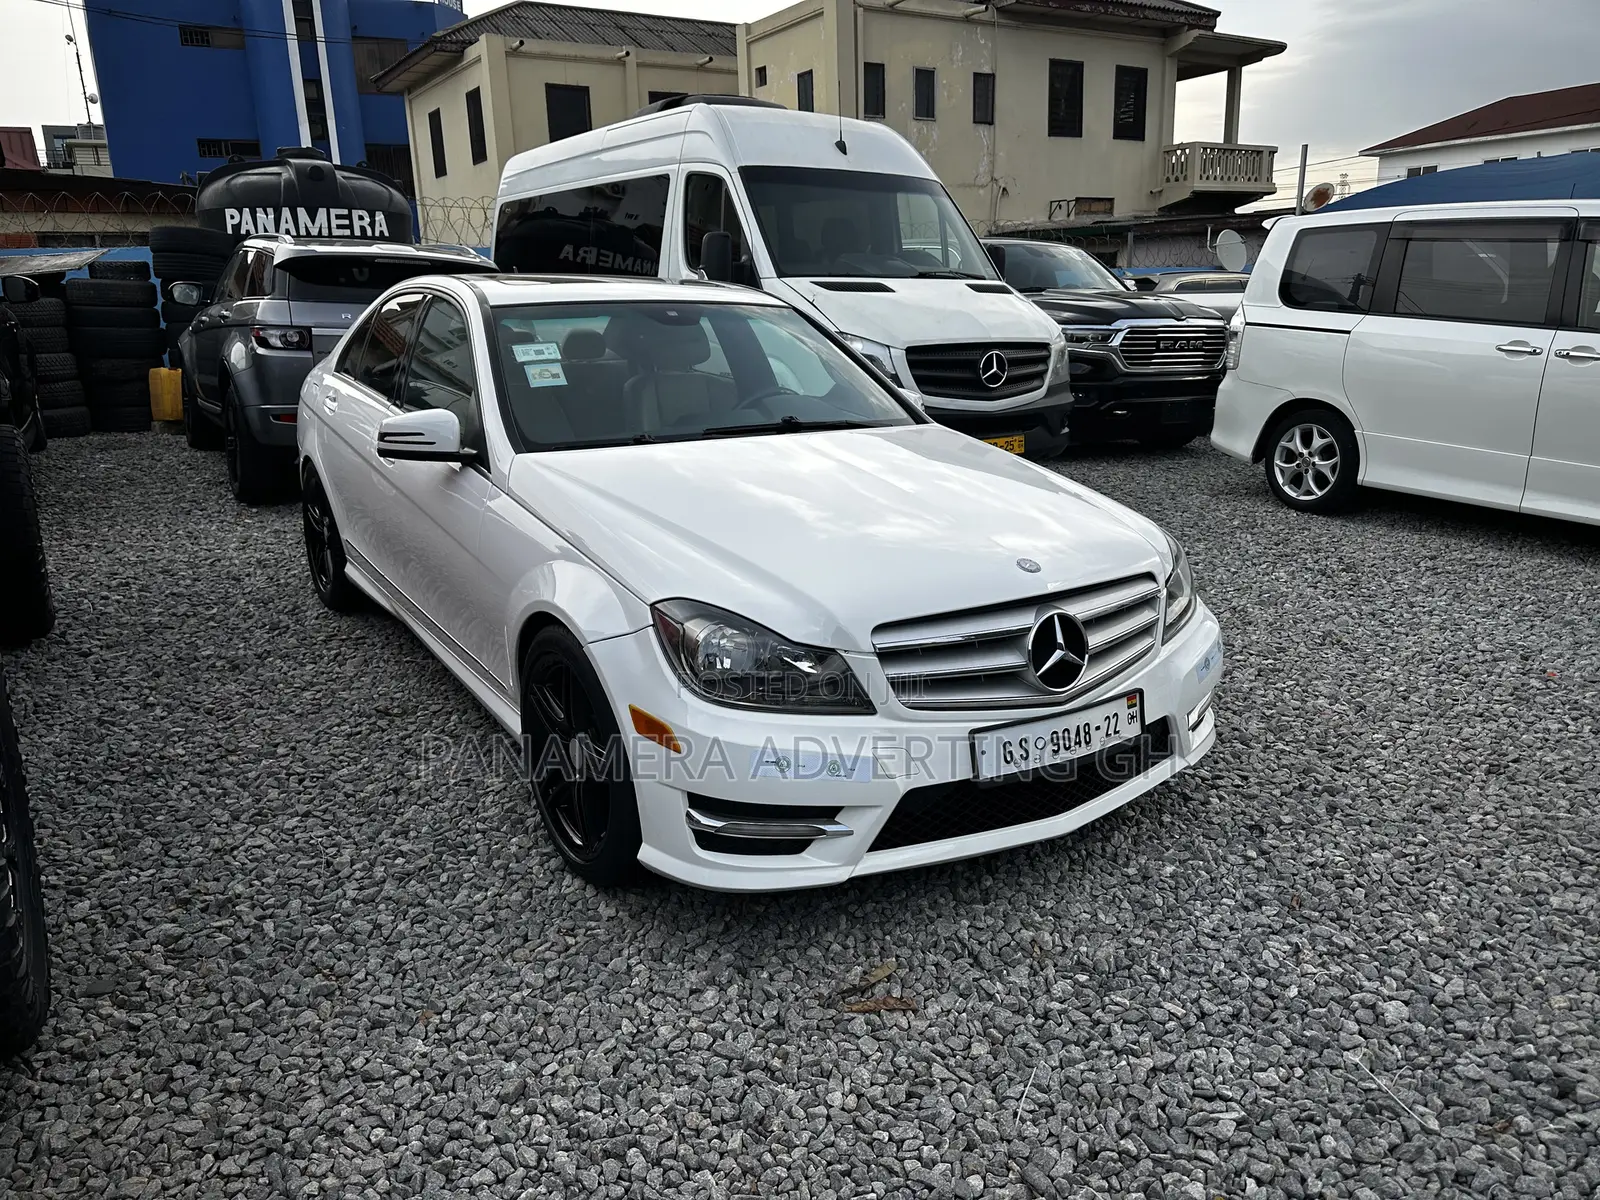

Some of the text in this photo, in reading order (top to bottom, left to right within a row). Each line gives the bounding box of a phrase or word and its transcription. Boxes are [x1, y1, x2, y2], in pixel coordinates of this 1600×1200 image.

[224, 206, 390, 237] PANAMERA
[1159, 340, 1204, 349] RAM
[1050, 712, 1121, 754] 9048-22
